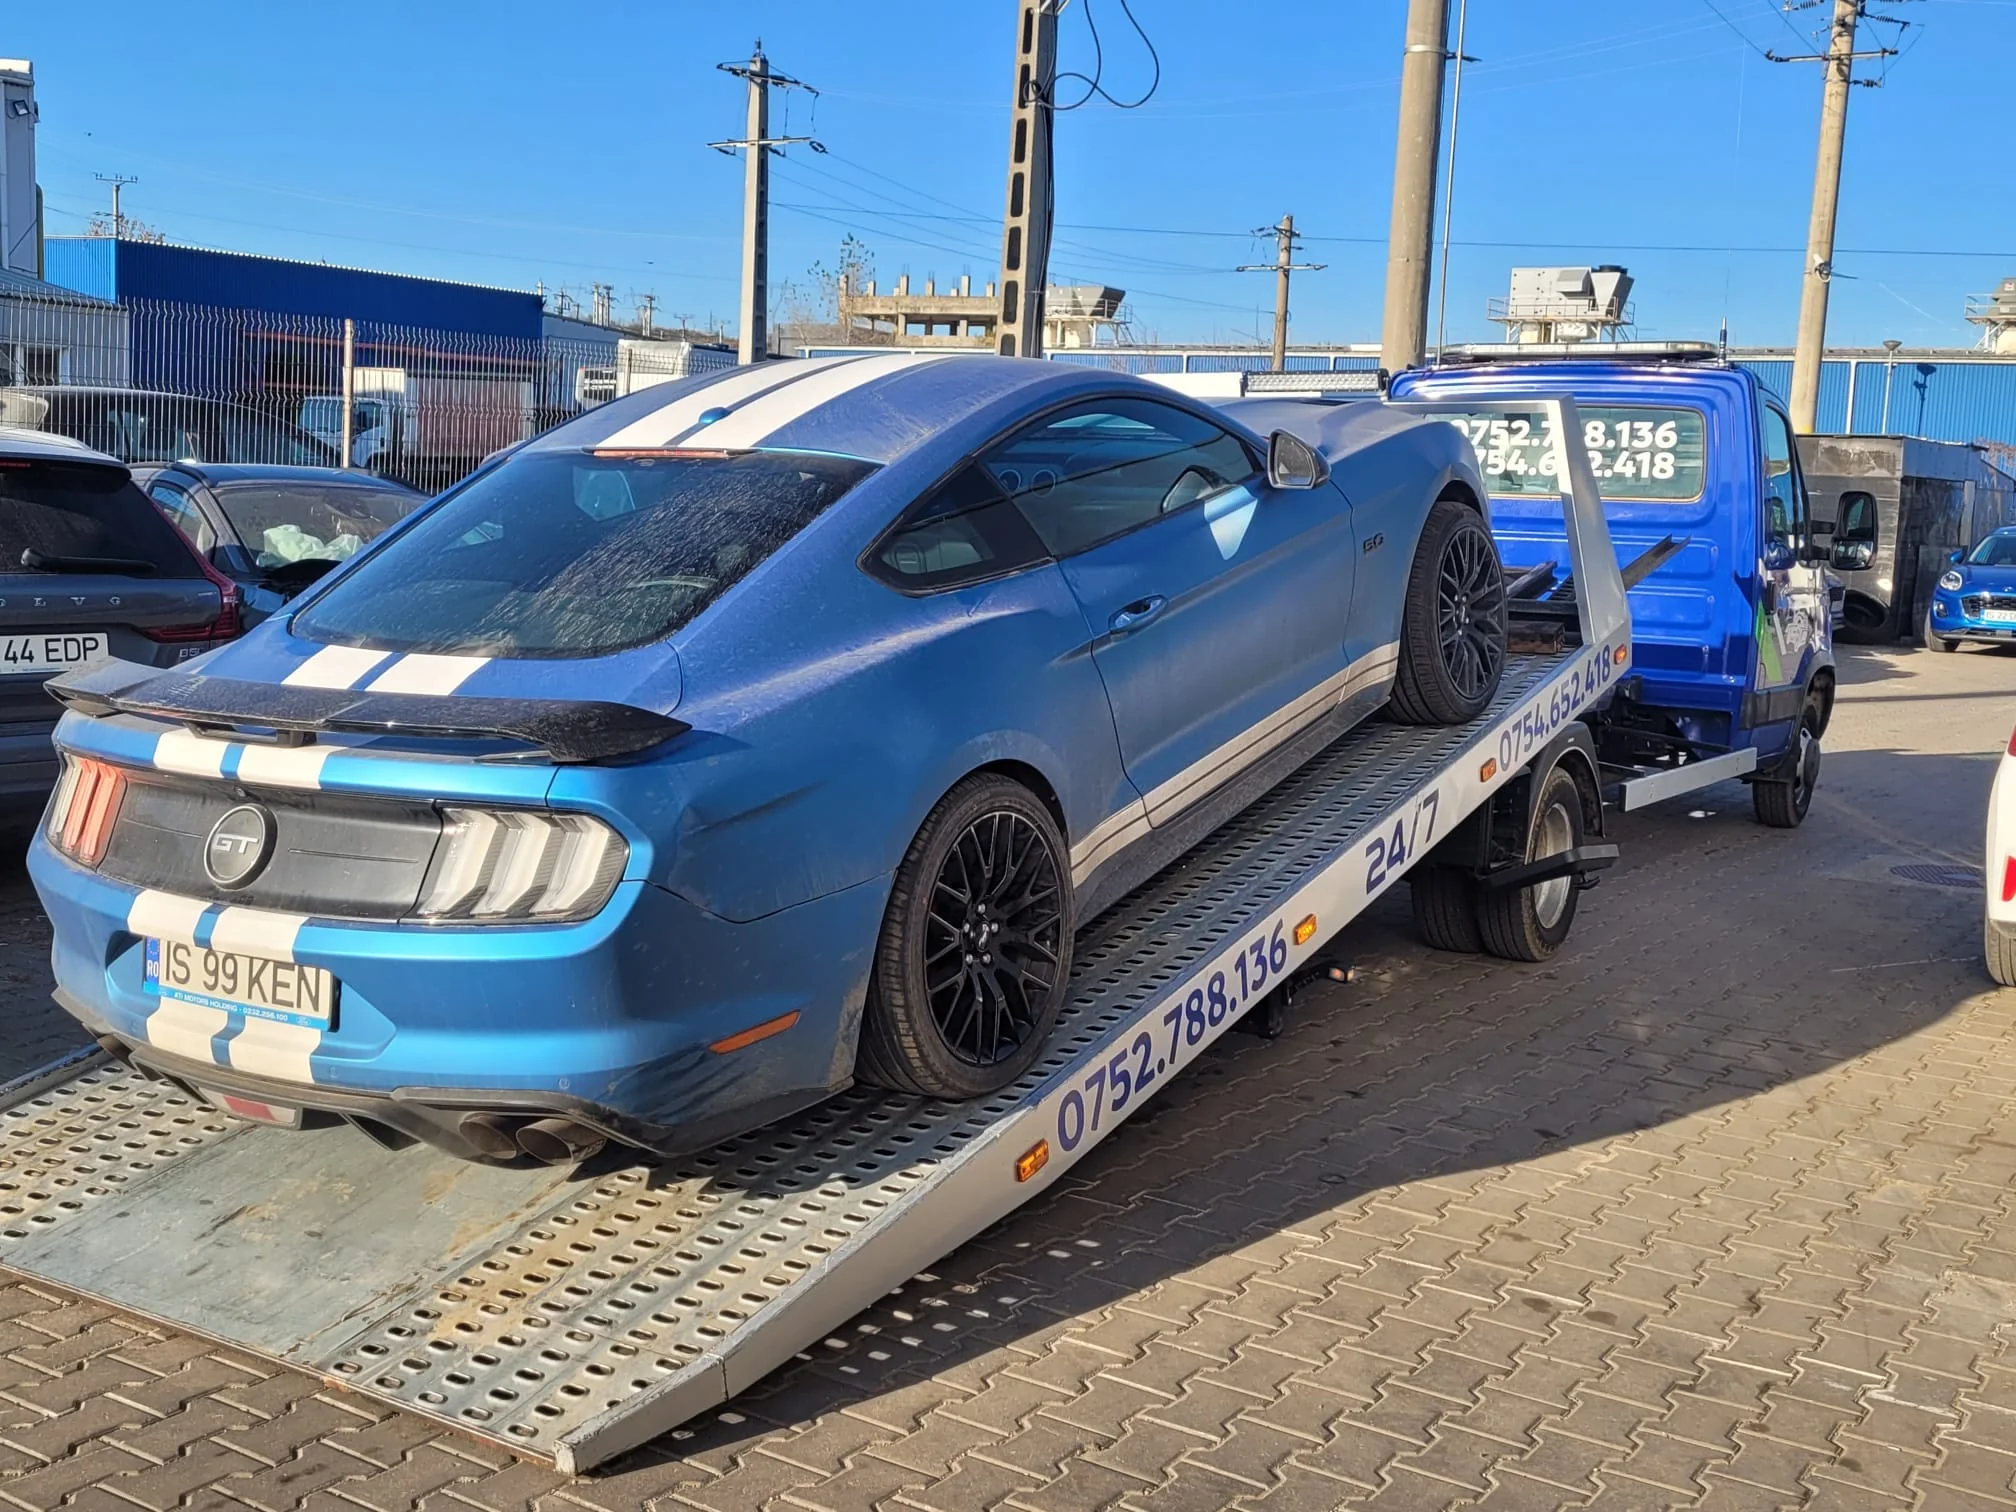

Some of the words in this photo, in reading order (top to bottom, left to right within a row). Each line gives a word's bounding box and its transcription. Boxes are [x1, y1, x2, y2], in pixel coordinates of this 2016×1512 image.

[1450, 419, 1678, 450] 752.78.136
[4, 639, 35, 664] 44
[45, 637, 99, 663] EDP
[1499, 644, 1611, 772] 0754.652.418
[213, 833, 259, 854] GT
[1365, 788, 1440, 895] 24/7
[147, 959, 159, 978] RO
[165, 940, 191, 985] IS
[203, 949, 238, 995] 99
[247, 958, 321, 1013] KEN
[209, 999, 238, 1012] HOLDING
[1057, 918, 1288, 1152] 0752.788.136
